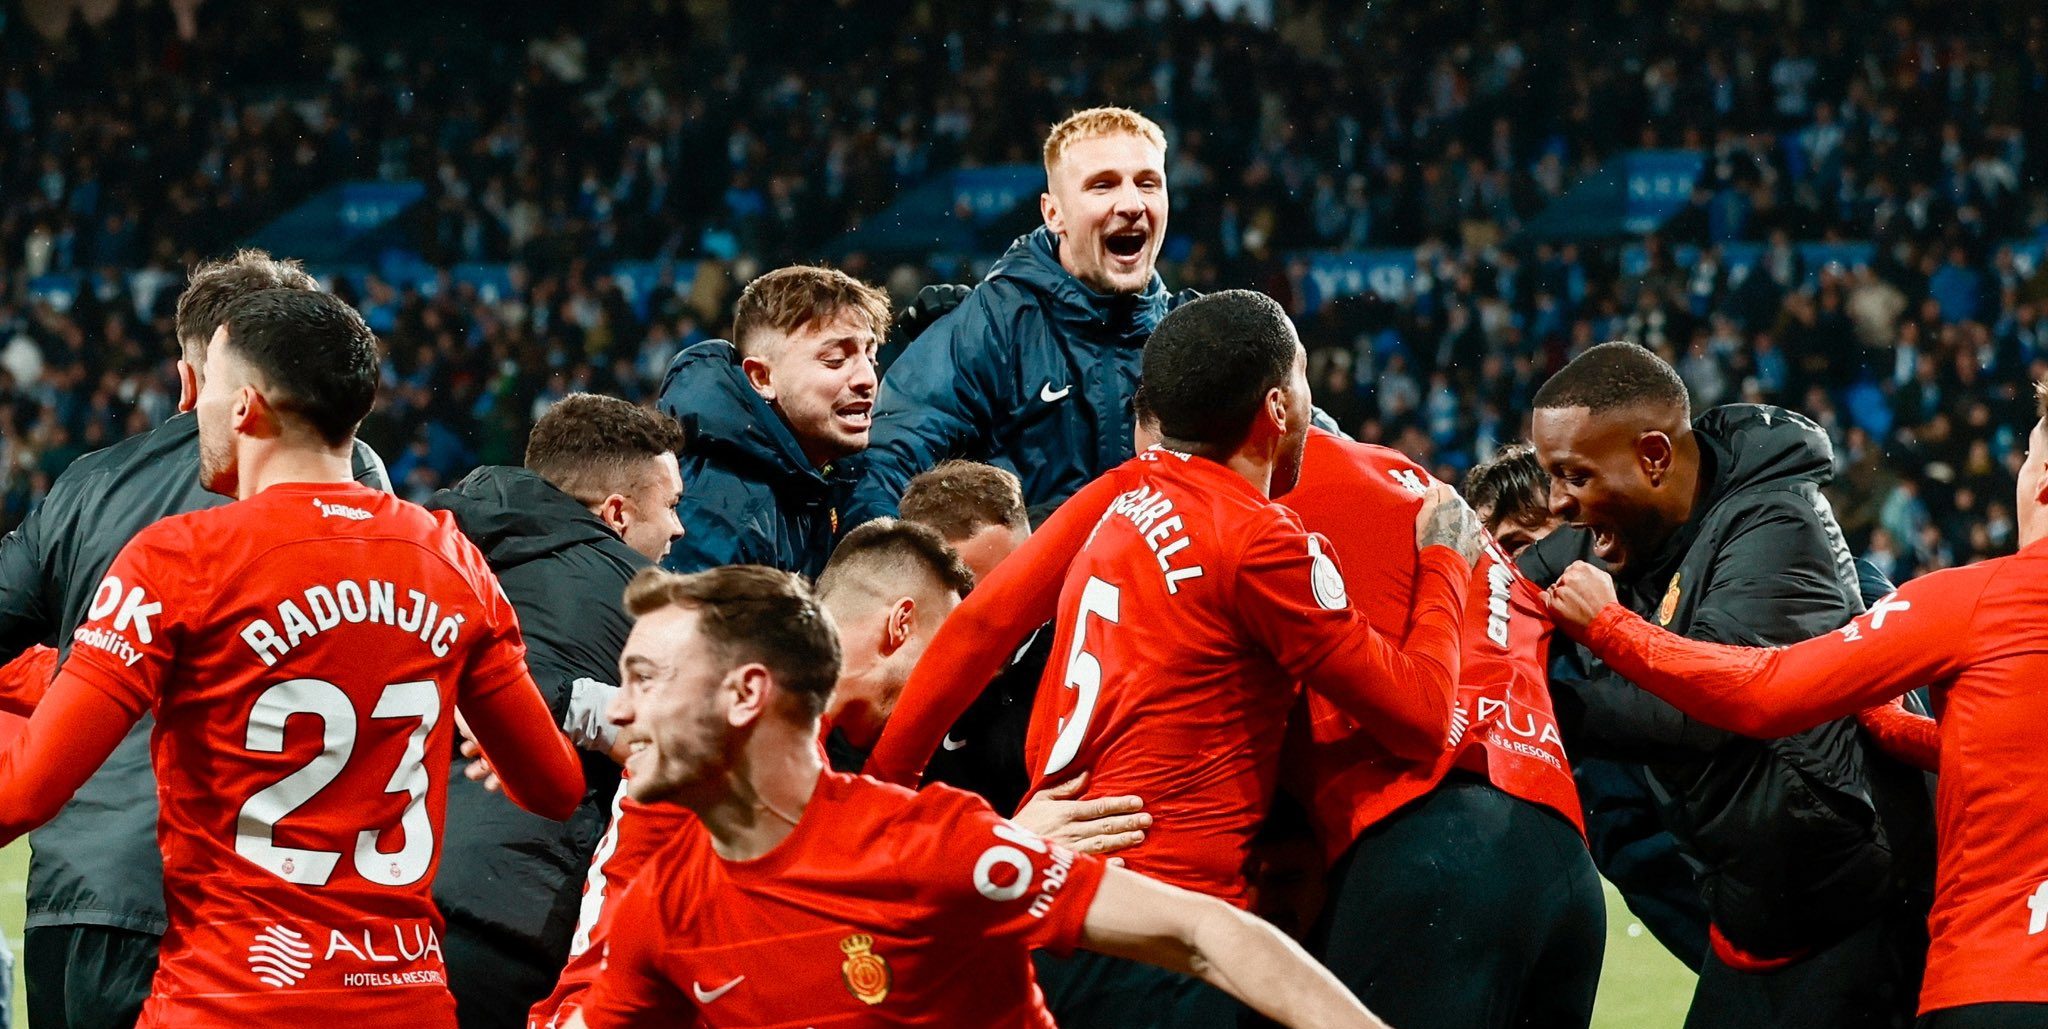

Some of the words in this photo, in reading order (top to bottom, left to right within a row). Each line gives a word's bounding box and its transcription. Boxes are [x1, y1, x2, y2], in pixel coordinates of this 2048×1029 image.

[88, 575, 163, 644] OK
[239, 579, 466, 667] RADONJIĆ
[1043, 575, 1121, 776] 5
[234, 678, 442, 887] 23
[1513, 741, 1562, 769] RESORTS
[324, 924, 445, 963] ALUA
[344, 973, 392, 986] HOTELS
[392, 973, 403, 985] &
